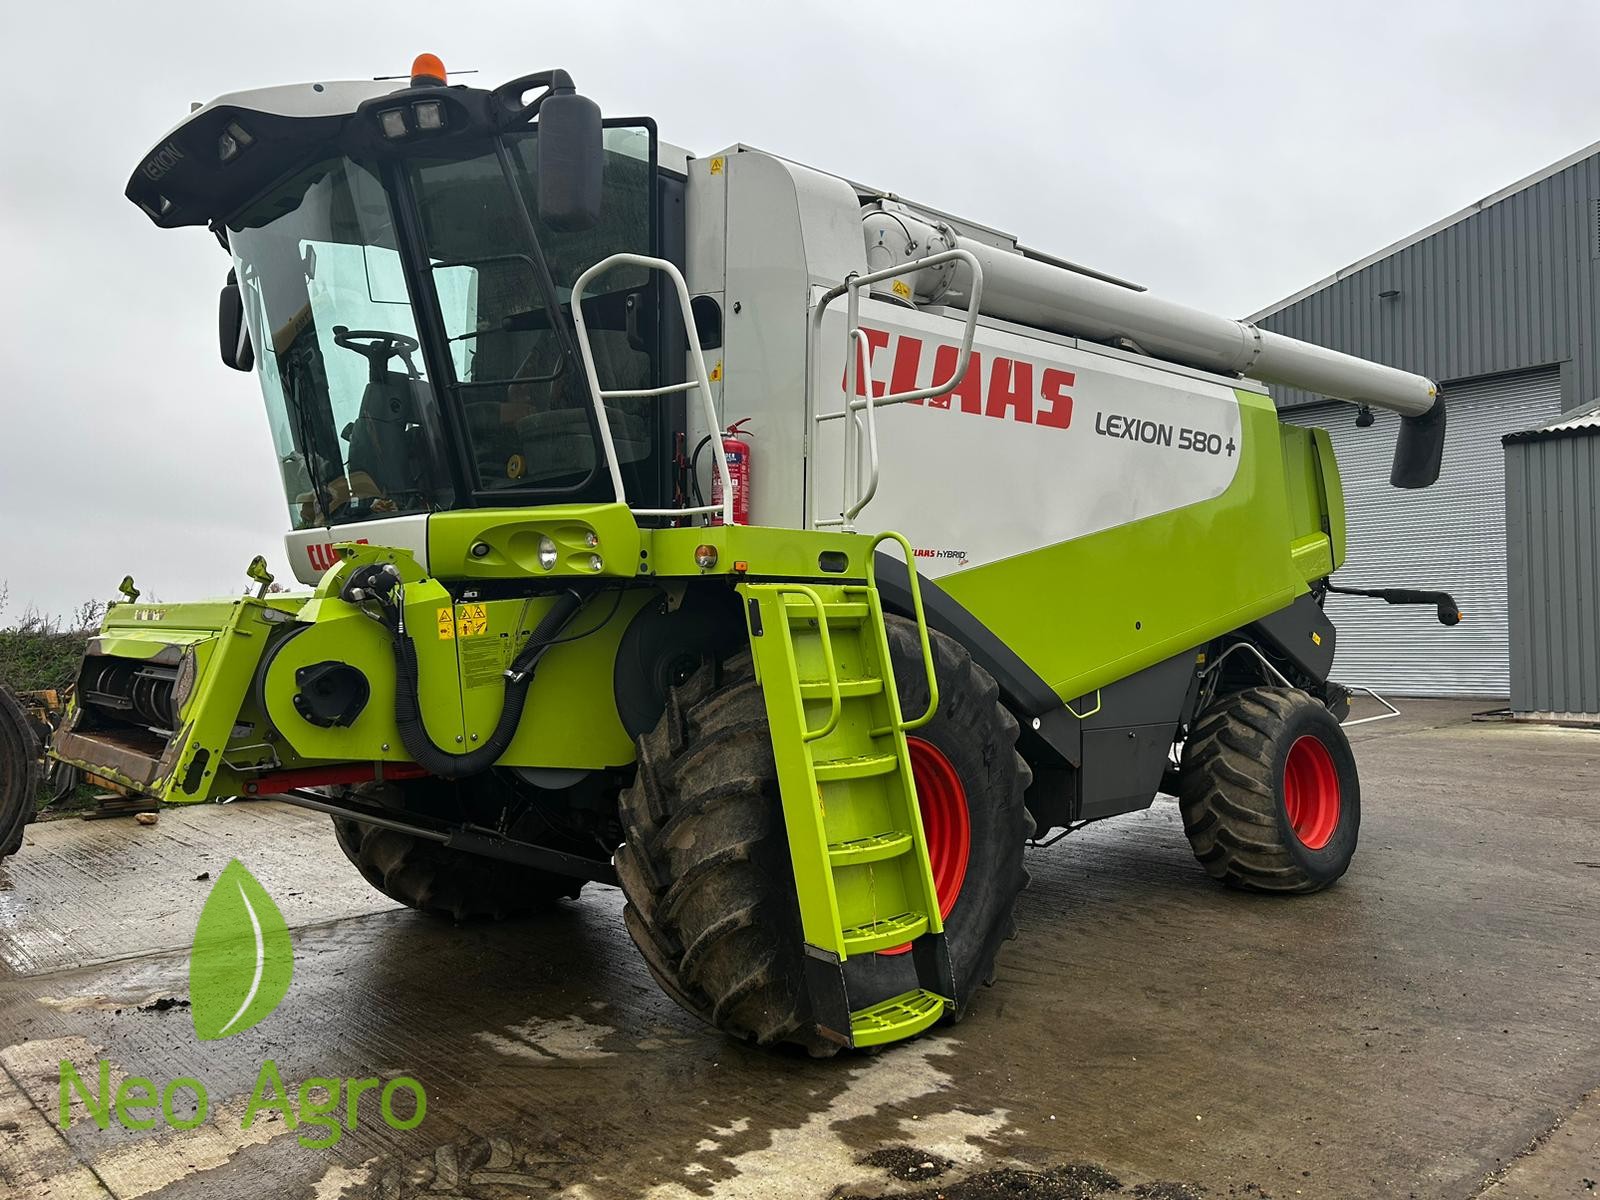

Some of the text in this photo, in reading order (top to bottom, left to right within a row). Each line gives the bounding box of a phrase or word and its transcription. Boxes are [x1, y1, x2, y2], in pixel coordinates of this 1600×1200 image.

[142, 142, 184, 181] LEXION
[1095, 411, 1173, 447] LEXION
[1178, 427, 1222, 455] 580
[912, 549, 935, 558] LAAS
